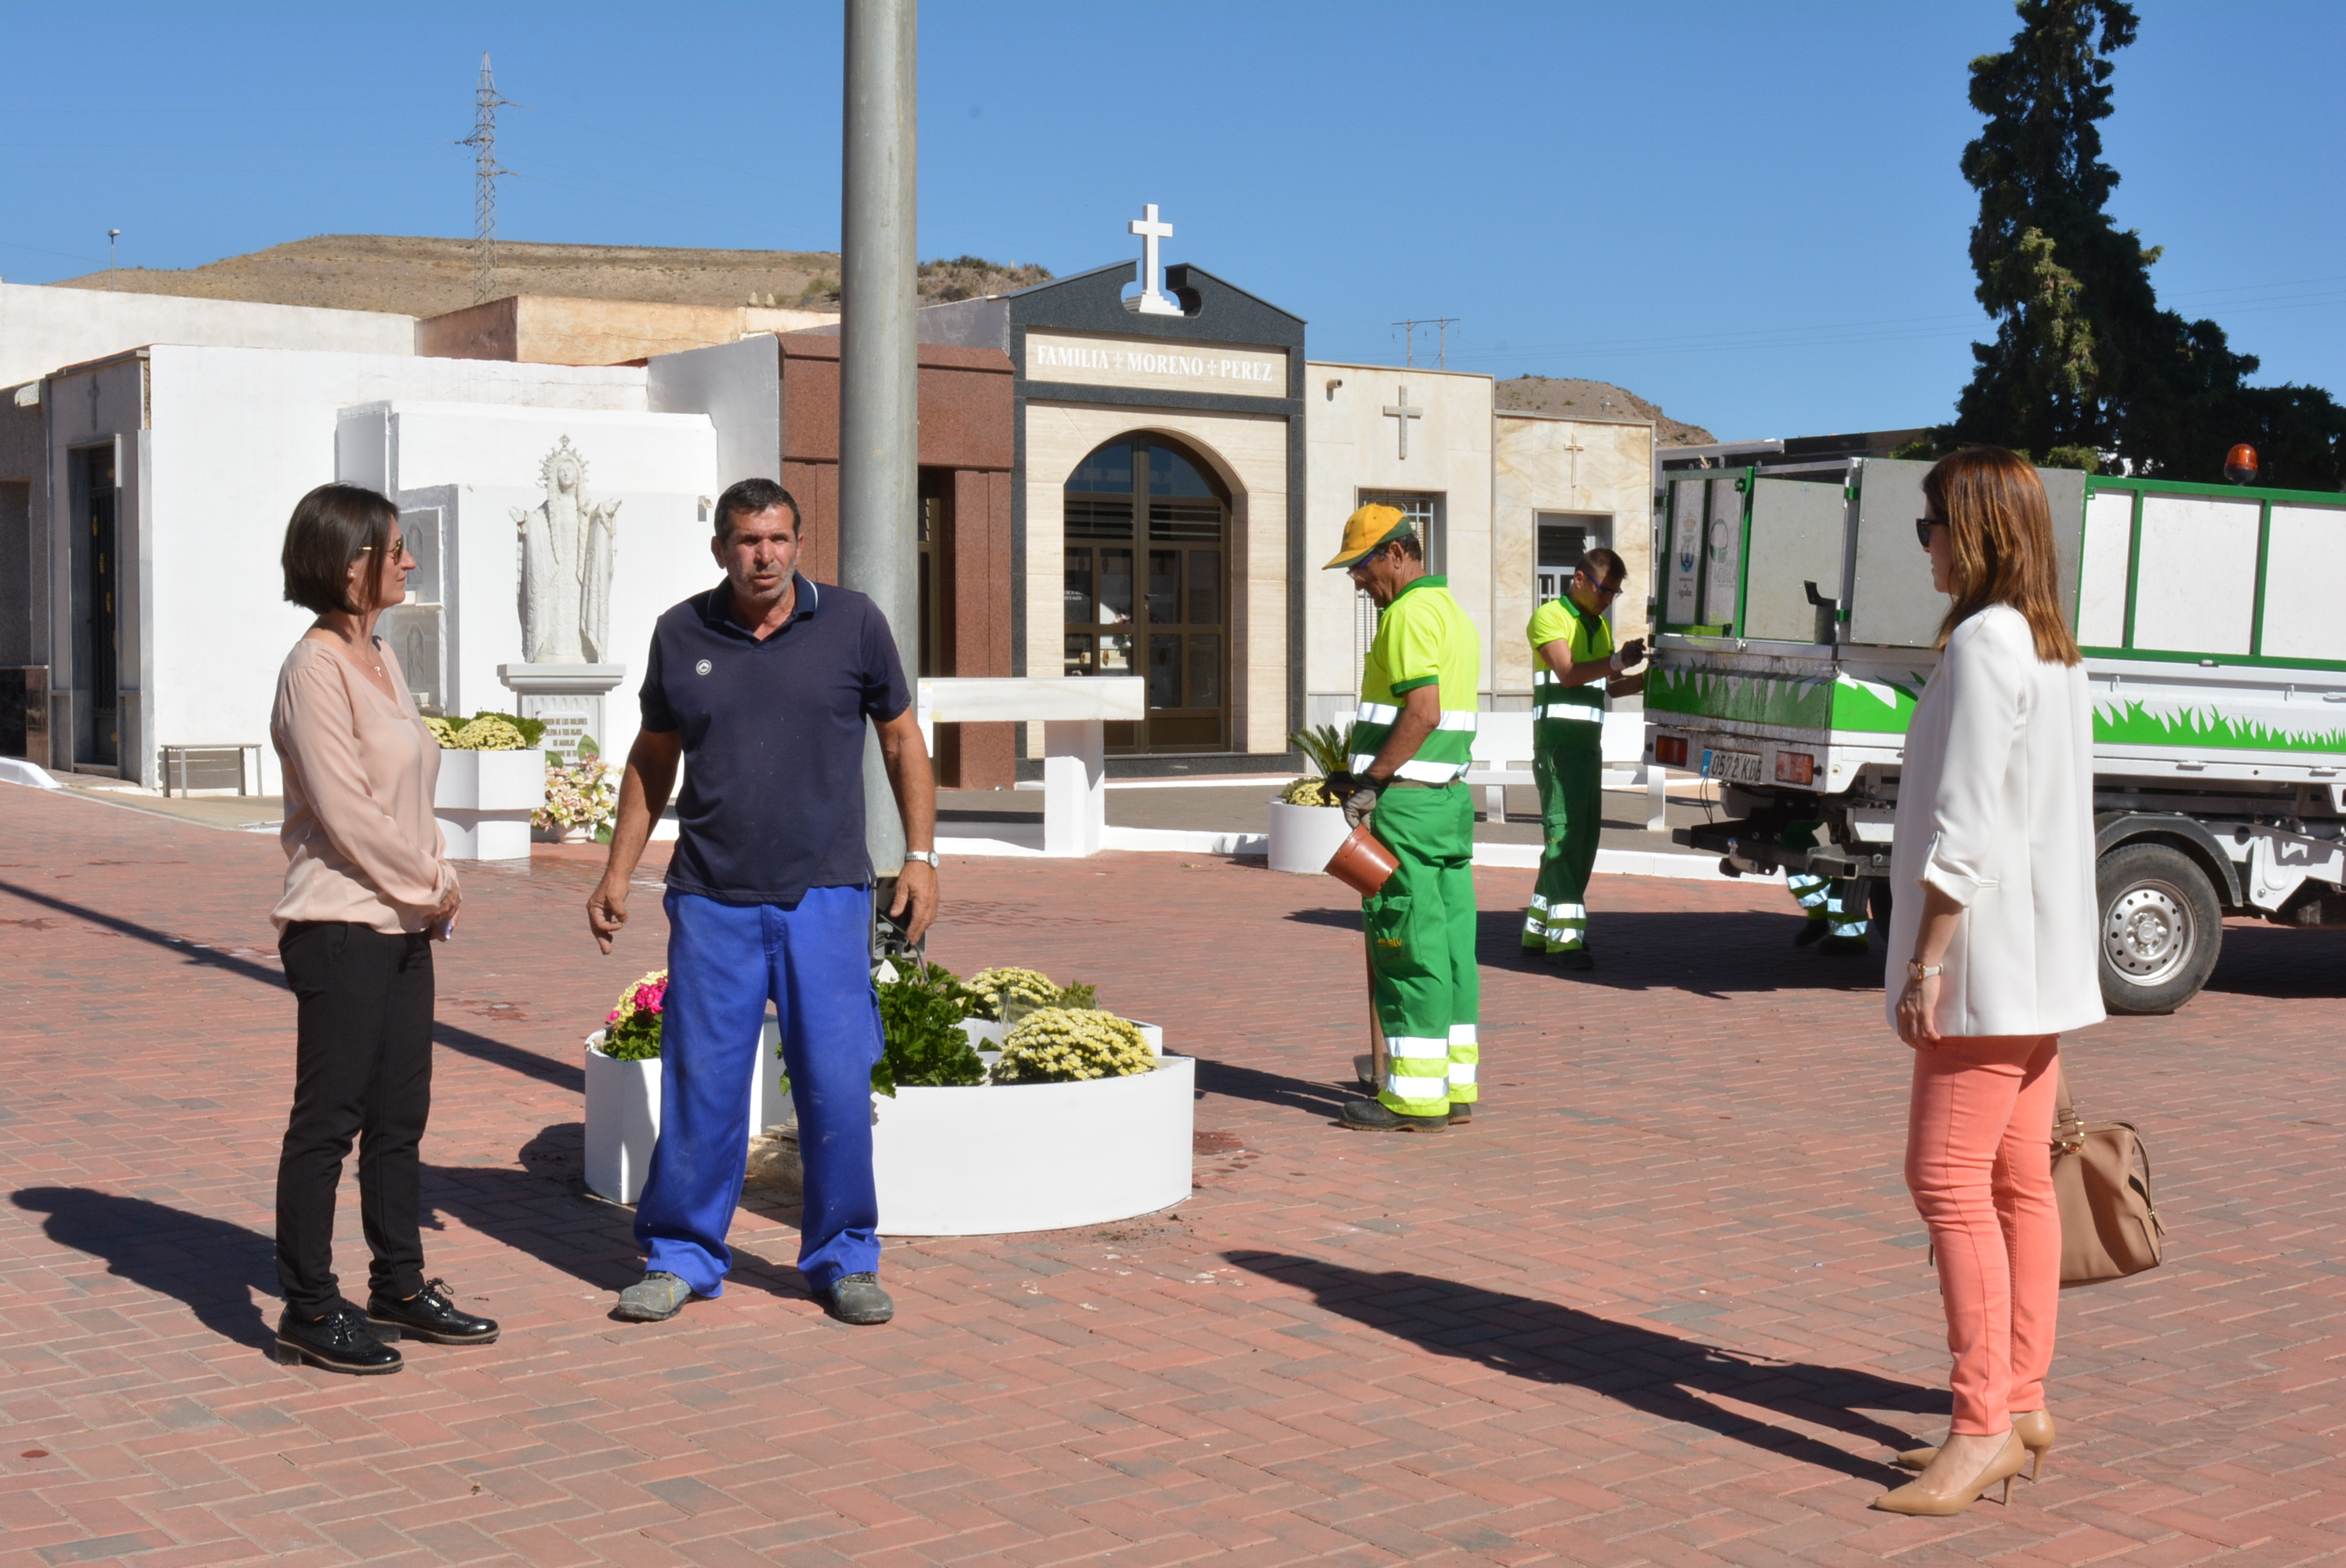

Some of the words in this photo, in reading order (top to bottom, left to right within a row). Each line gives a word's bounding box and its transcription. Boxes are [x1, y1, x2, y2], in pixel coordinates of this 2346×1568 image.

[1037, 345, 1109, 369] FAMILIA
[1128, 353, 1203, 376] MORENO
[1221, 359, 1273, 382] PEREZ
[1712, 754, 1739, 778] 0572
